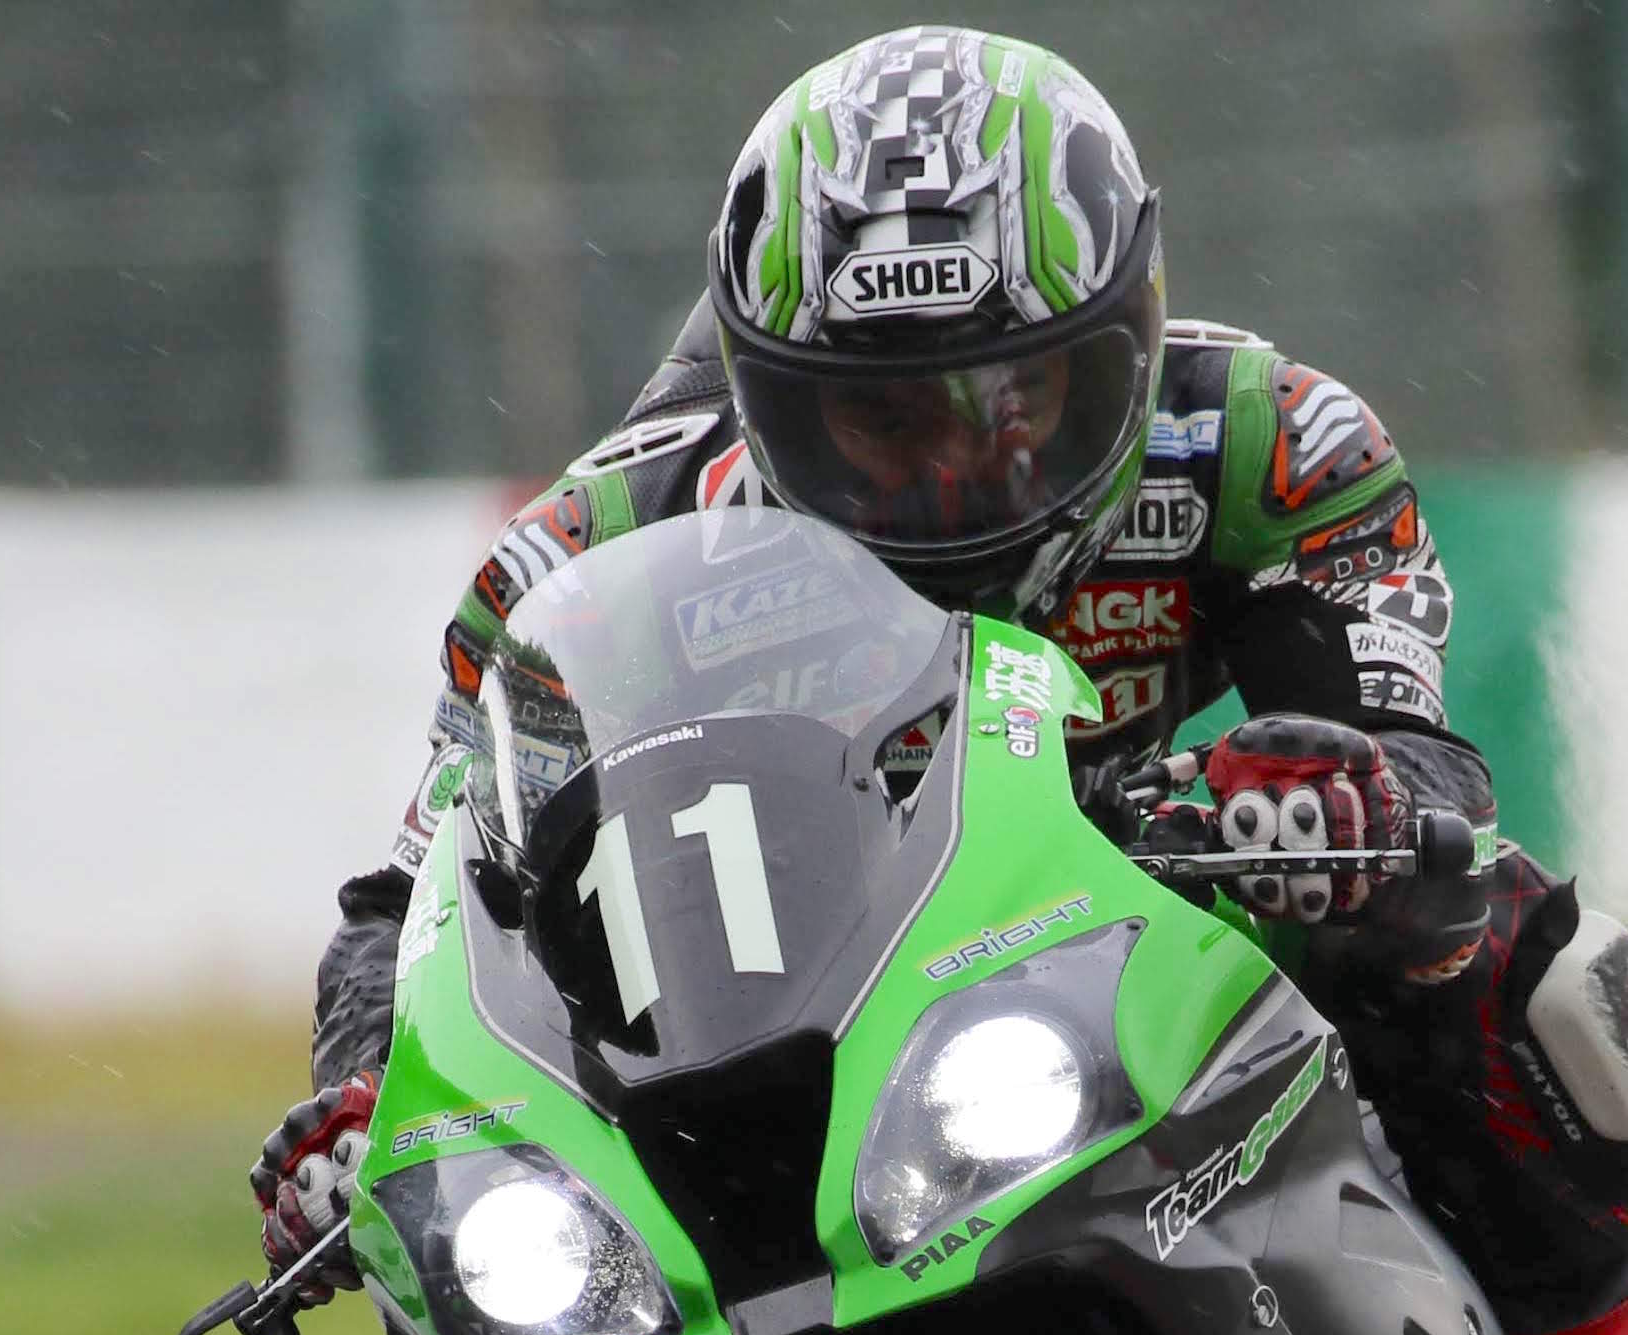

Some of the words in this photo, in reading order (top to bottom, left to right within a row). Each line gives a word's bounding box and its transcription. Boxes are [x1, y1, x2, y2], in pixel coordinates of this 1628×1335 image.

[852, 257, 971, 301] SHOEI
[1067, 636, 1118, 658] PARK
[603, 723, 704, 772] Kawasaki
[1007, 723, 1038, 758] elf
[576, 783, 785, 1025] 11
[899, 1215, 996, 1283] PIAA
